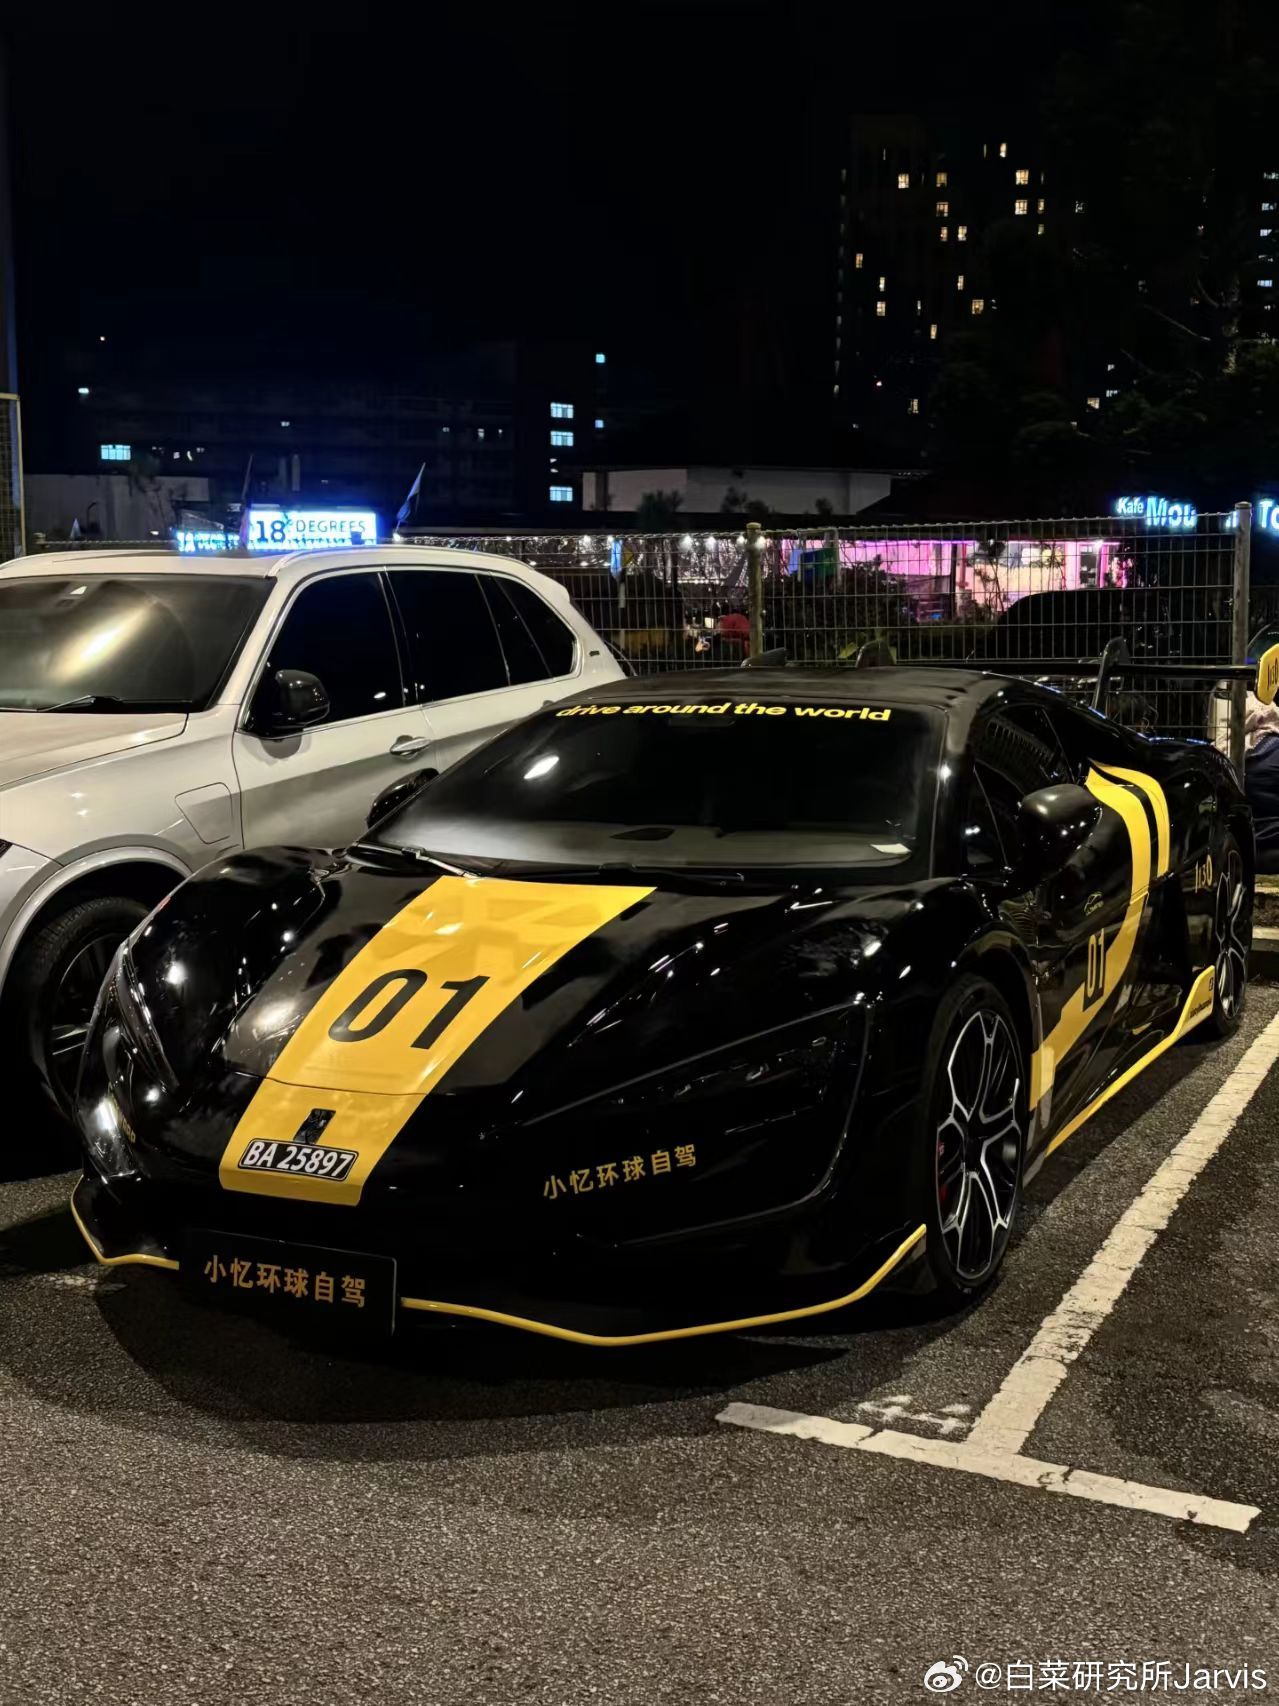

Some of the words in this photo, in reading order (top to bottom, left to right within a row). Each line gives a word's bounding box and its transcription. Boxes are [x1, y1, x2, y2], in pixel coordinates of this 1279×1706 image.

[296, 519, 366, 533] DEGREES
[1117, 496, 1144, 514] Kafe
[555, 704, 622, 717] drive
[622, 702, 732, 714] around
[733, 702, 787, 716] the
[794, 707, 892, 721] world
[1086, 927, 1105, 998] 01
[328, 968, 491, 1050] 01
[243, 1141, 277, 1167] BA
[277, 1144, 355, 1177] 25897
[542, 1143, 697, 1200] 小忆环球自驾
[204, 1254, 366, 1308] 小忆环球自驾
